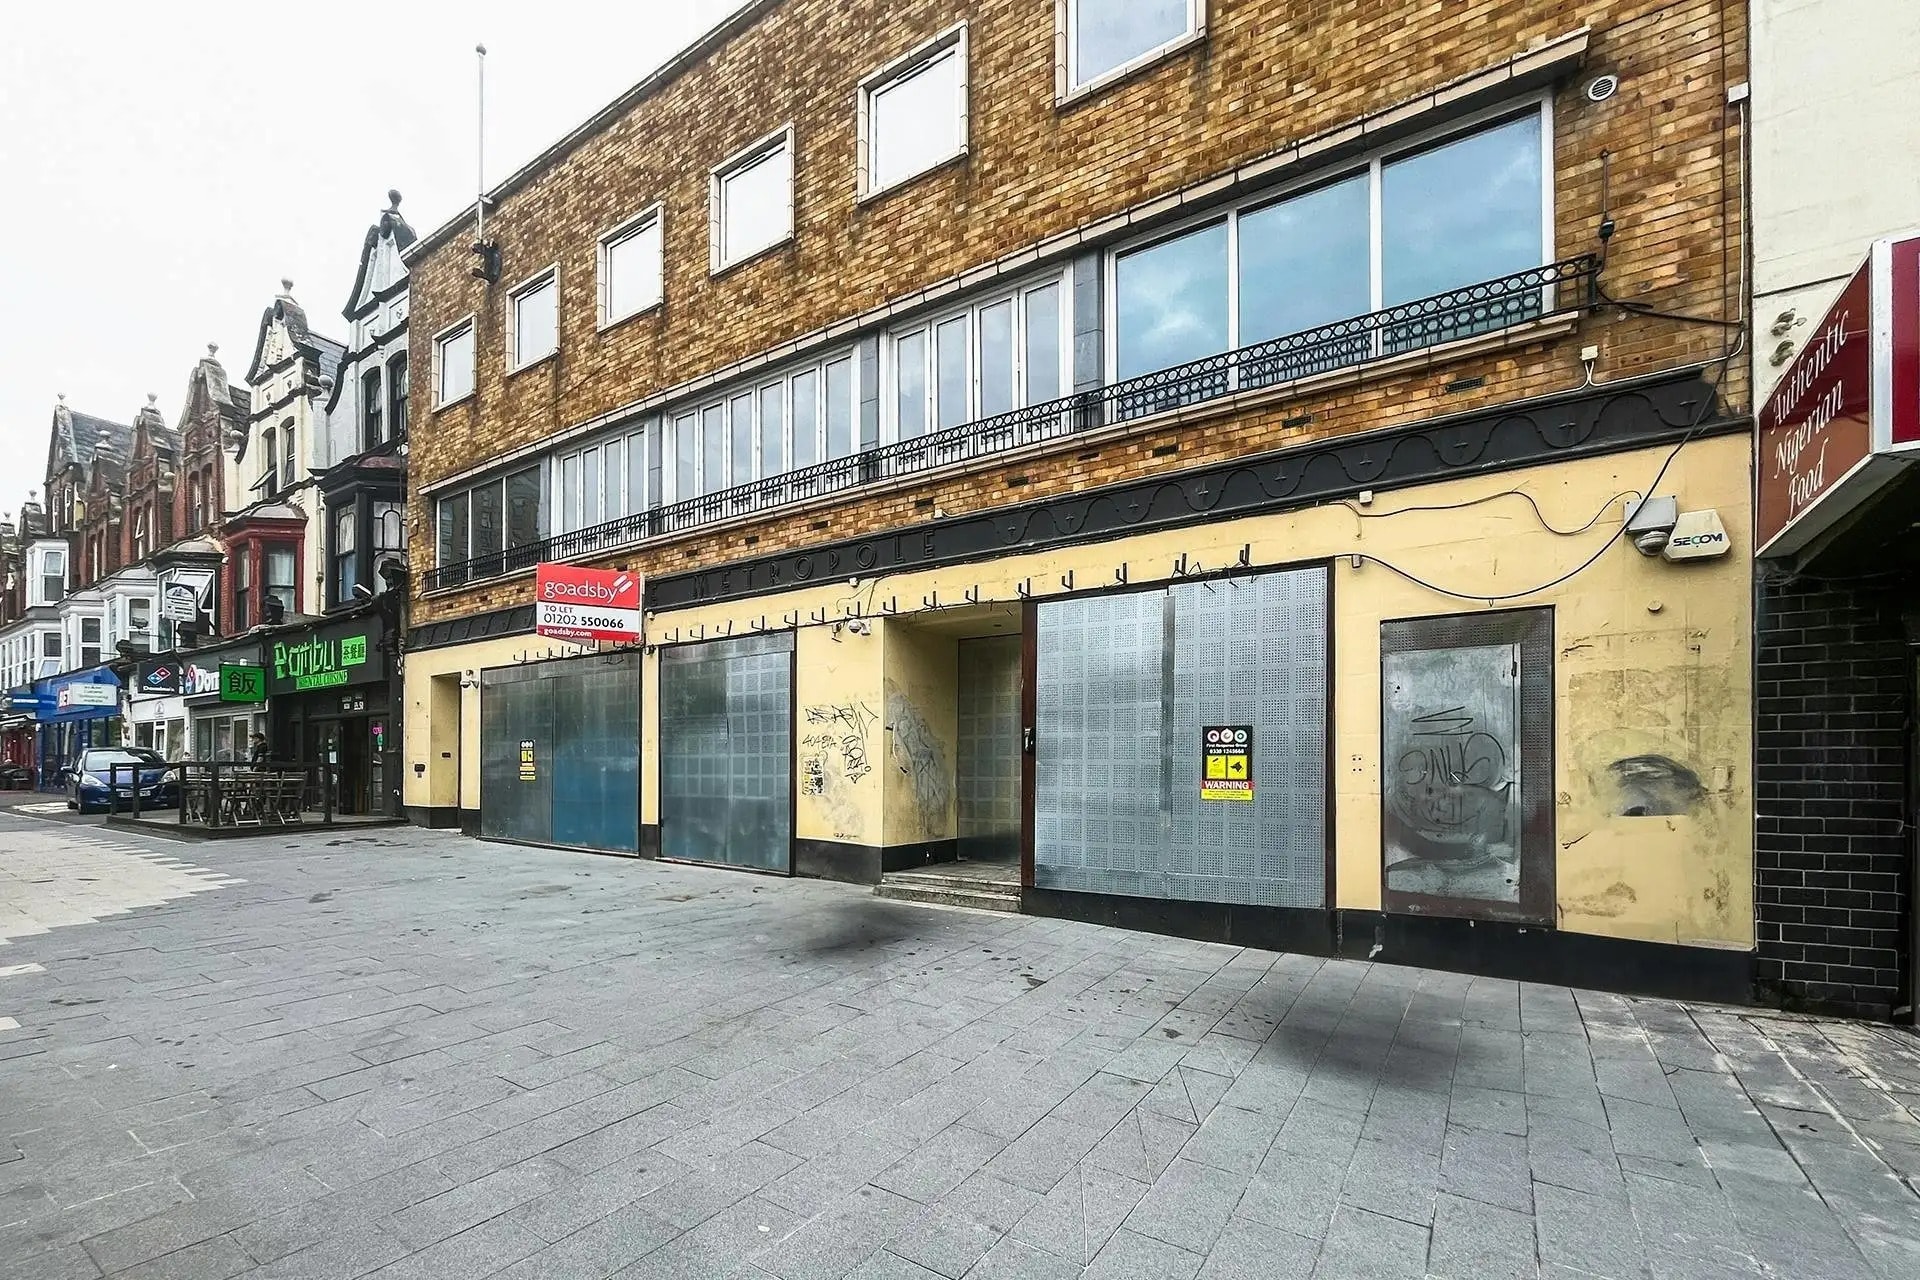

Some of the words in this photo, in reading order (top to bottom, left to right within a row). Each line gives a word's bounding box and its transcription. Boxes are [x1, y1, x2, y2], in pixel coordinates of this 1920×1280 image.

[1771, 310, 1849, 435] Authentic
[1774, 379, 1844, 479] Nigerian
[1786, 437, 1829, 525] Food
[1673, 533, 1722, 547] SECOM
[691, 529, 937, 600] METROPOLE
[544, 579, 617, 604] goadsby
[543, 613, 577, 624] 01202
[581, 616, 624, 629] 550066
[543, 627, 592, 637] goadsby.com
[195, 668, 220, 693] Dom
[227, 670, 258, 695] 飯
[1204, 781, 1249, 789] WARNING
